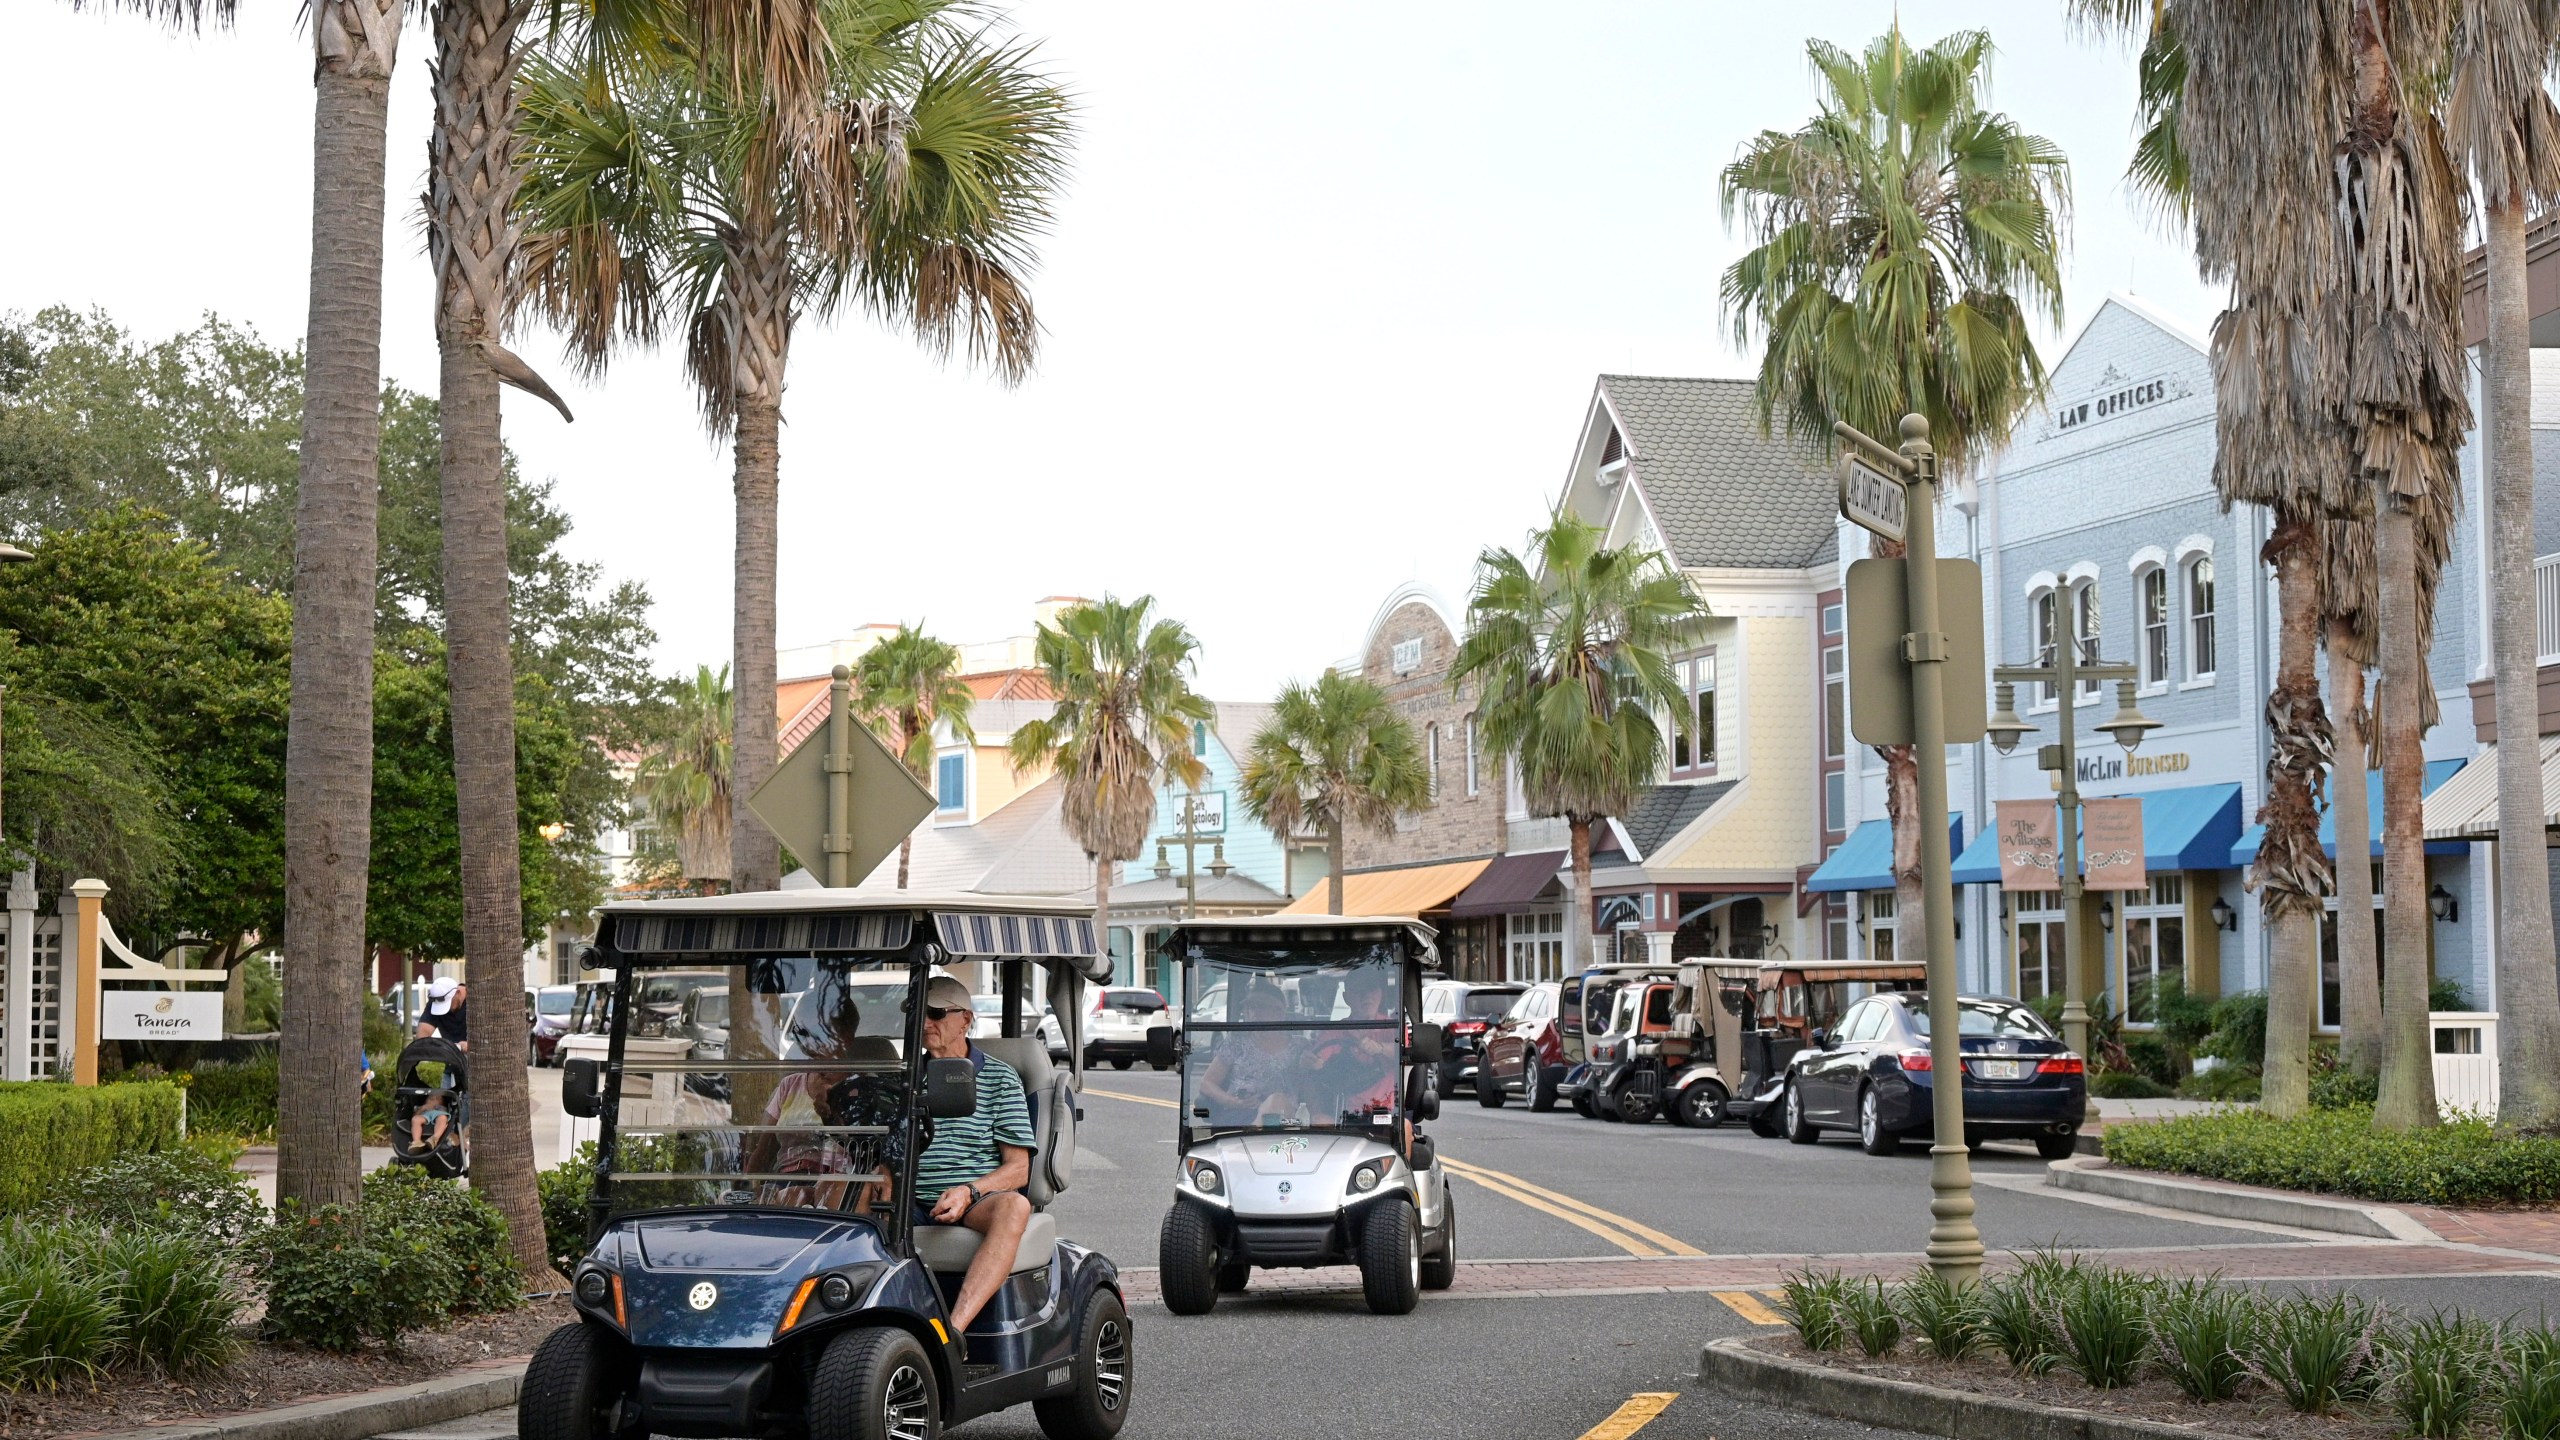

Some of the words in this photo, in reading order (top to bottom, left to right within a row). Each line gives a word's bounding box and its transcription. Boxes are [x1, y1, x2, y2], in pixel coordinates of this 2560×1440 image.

[2059, 403, 2089, 429] LAW
[2097, 380, 2165, 417] OFFICES
[1848, 466, 1861, 507] LAKE
[1861, 473, 1881, 517] SUMTER
[1881, 483, 1903, 528] LANDING
[1176, 811, 1221, 825] Deatology
[2011, 819, 2037, 834] The
[2001, 832, 2053, 848] Villages
[134, 1014, 191, 1027] Panera
[1047, 1364, 1071, 1388] YAMAHA
